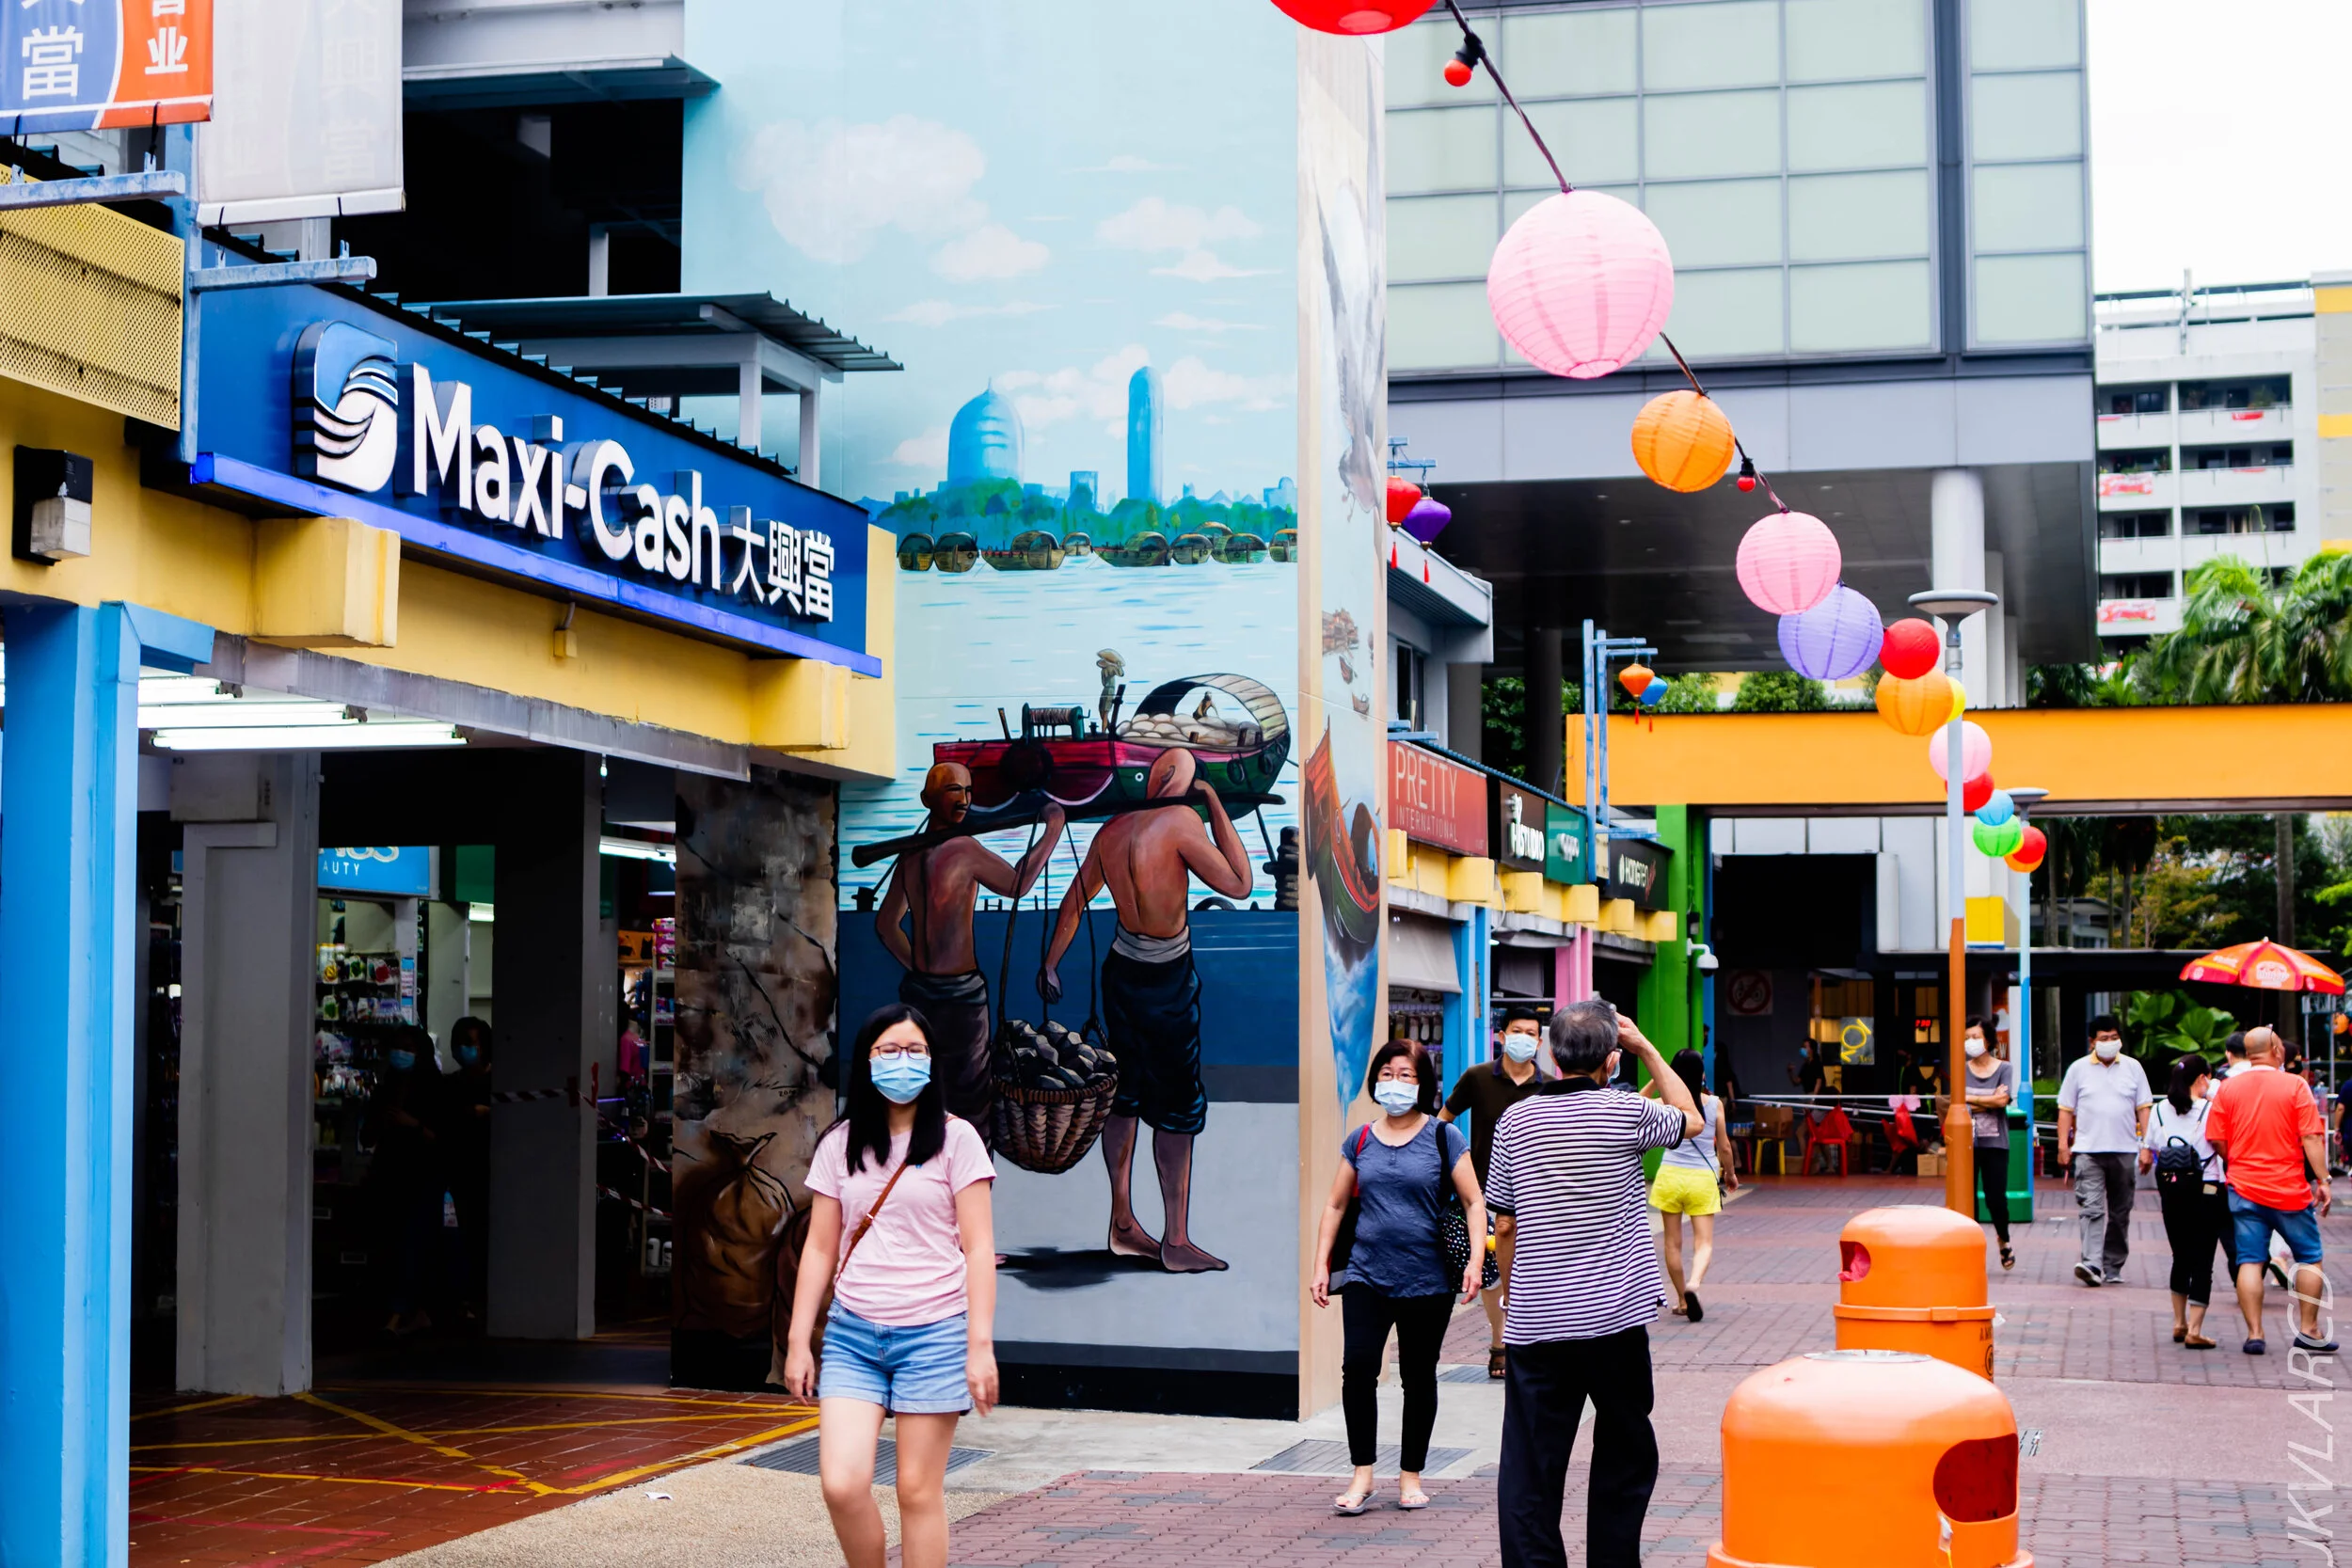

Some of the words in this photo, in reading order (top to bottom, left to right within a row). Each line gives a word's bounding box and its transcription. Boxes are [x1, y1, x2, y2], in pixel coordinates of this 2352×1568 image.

[22, 0, 85, 101] 當
[412, 361, 722, 591] Maxi-Cash
[731, 506, 834, 623] 大興當
[1396, 745, 1457, 817] PRETTY
[1396, 804, 1458, 842] INTERNATIONAL
